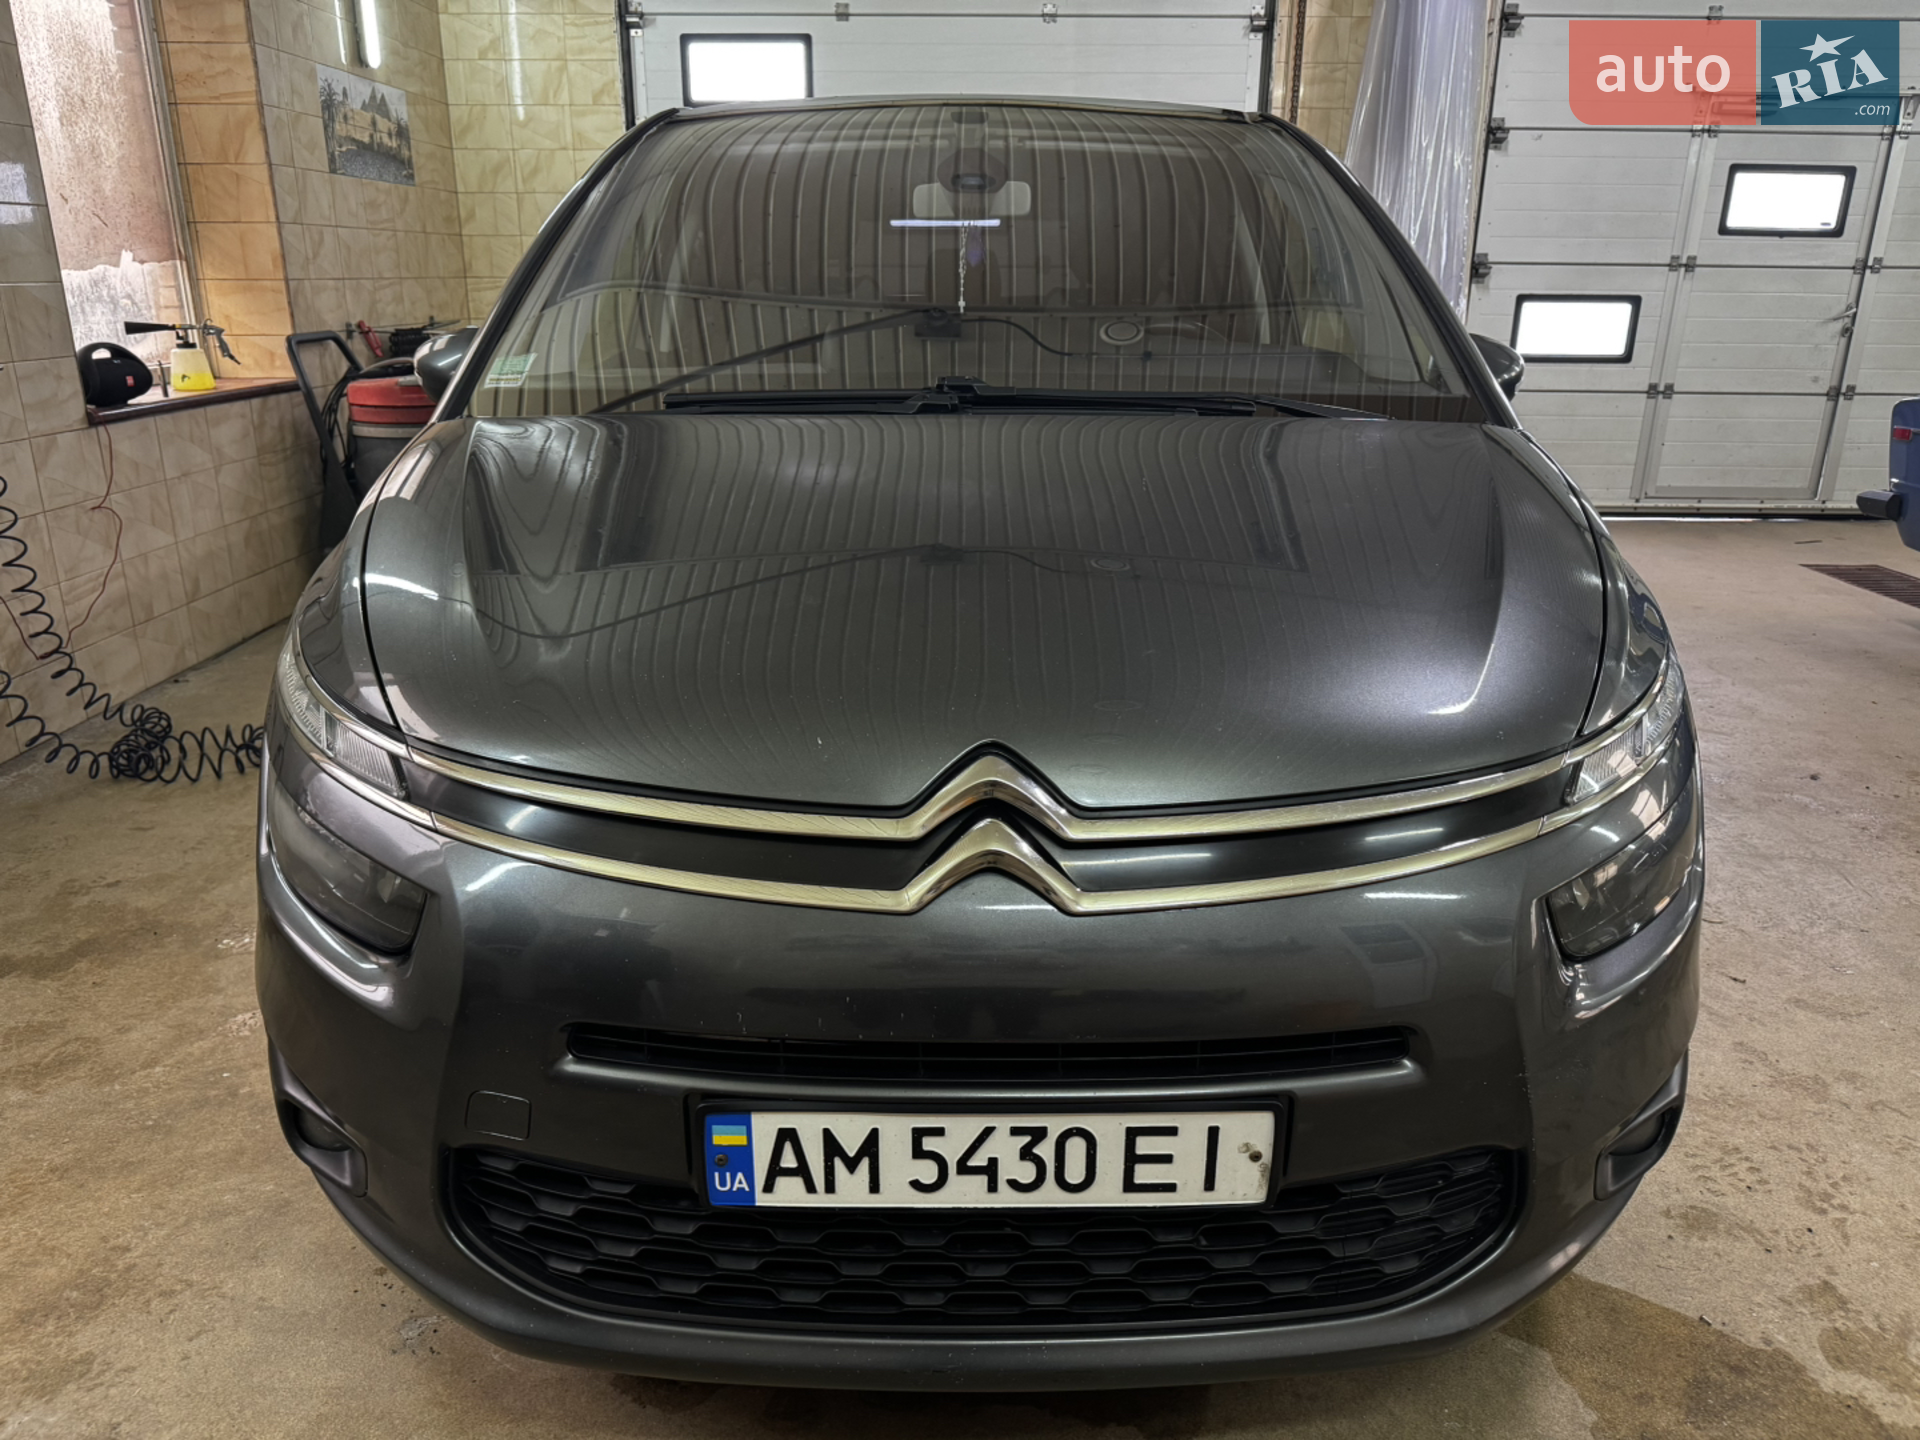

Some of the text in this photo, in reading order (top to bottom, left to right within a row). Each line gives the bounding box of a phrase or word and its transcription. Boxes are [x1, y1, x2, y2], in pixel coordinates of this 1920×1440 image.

[714, 1171, 750, 1192] UA
[761, 1125, 1221, 1195] AM 5430 EI
